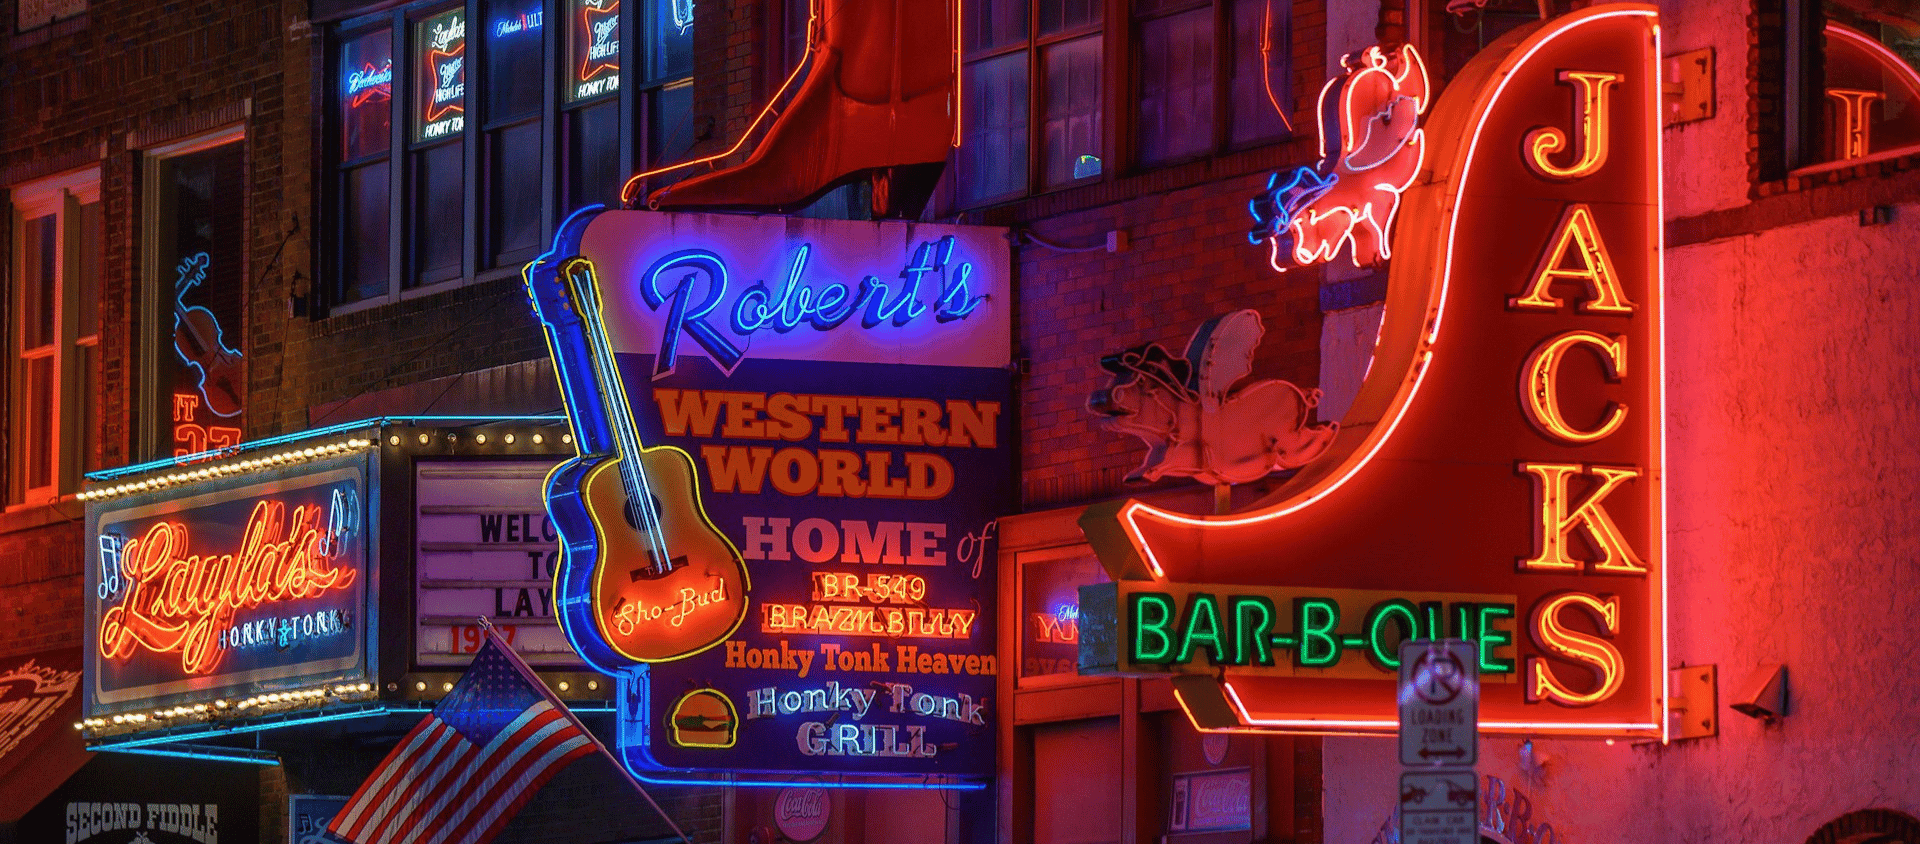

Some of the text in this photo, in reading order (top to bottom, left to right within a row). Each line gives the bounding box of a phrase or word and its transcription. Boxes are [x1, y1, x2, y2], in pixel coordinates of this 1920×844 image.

[590, 44, 606, 60] HIGH
[435, 87, 451, 103] HIGH
[577, 78, 606, 99] HONKY
[425, 119, 450, 138] HONKY
[640, 235, 982, 380] Robert's
[1508, 66, 1648, 708] JACKS
[653, 388, 1000, 449] WESTERN
[702, 444, 955, 500] WORLD
[743, 516, 998, 579] HOME of
[100, 500, 350, 674] Layla's
[614, 577, 727, 636] Sho-Bud
[811, 571, 927, 604] BR-549
[217, 608, 349, 650] HONKY TONK
[1128, 592, 1515, 673] BAR-B-QUE
[725, 640, 815, 678] Honky
[820, 643, 891, 672] Tonk
[896, 645, 998, 676] Heaven
[747, 681, 987, 726] Honky Tonk
[1411, 708, 1465, 726] LOADING
[796, 721, 939, 758] GRILL
[1421, 728, 1453, 744] ZONE
[66, 802, 218, 844] SECOND FIDDLE
